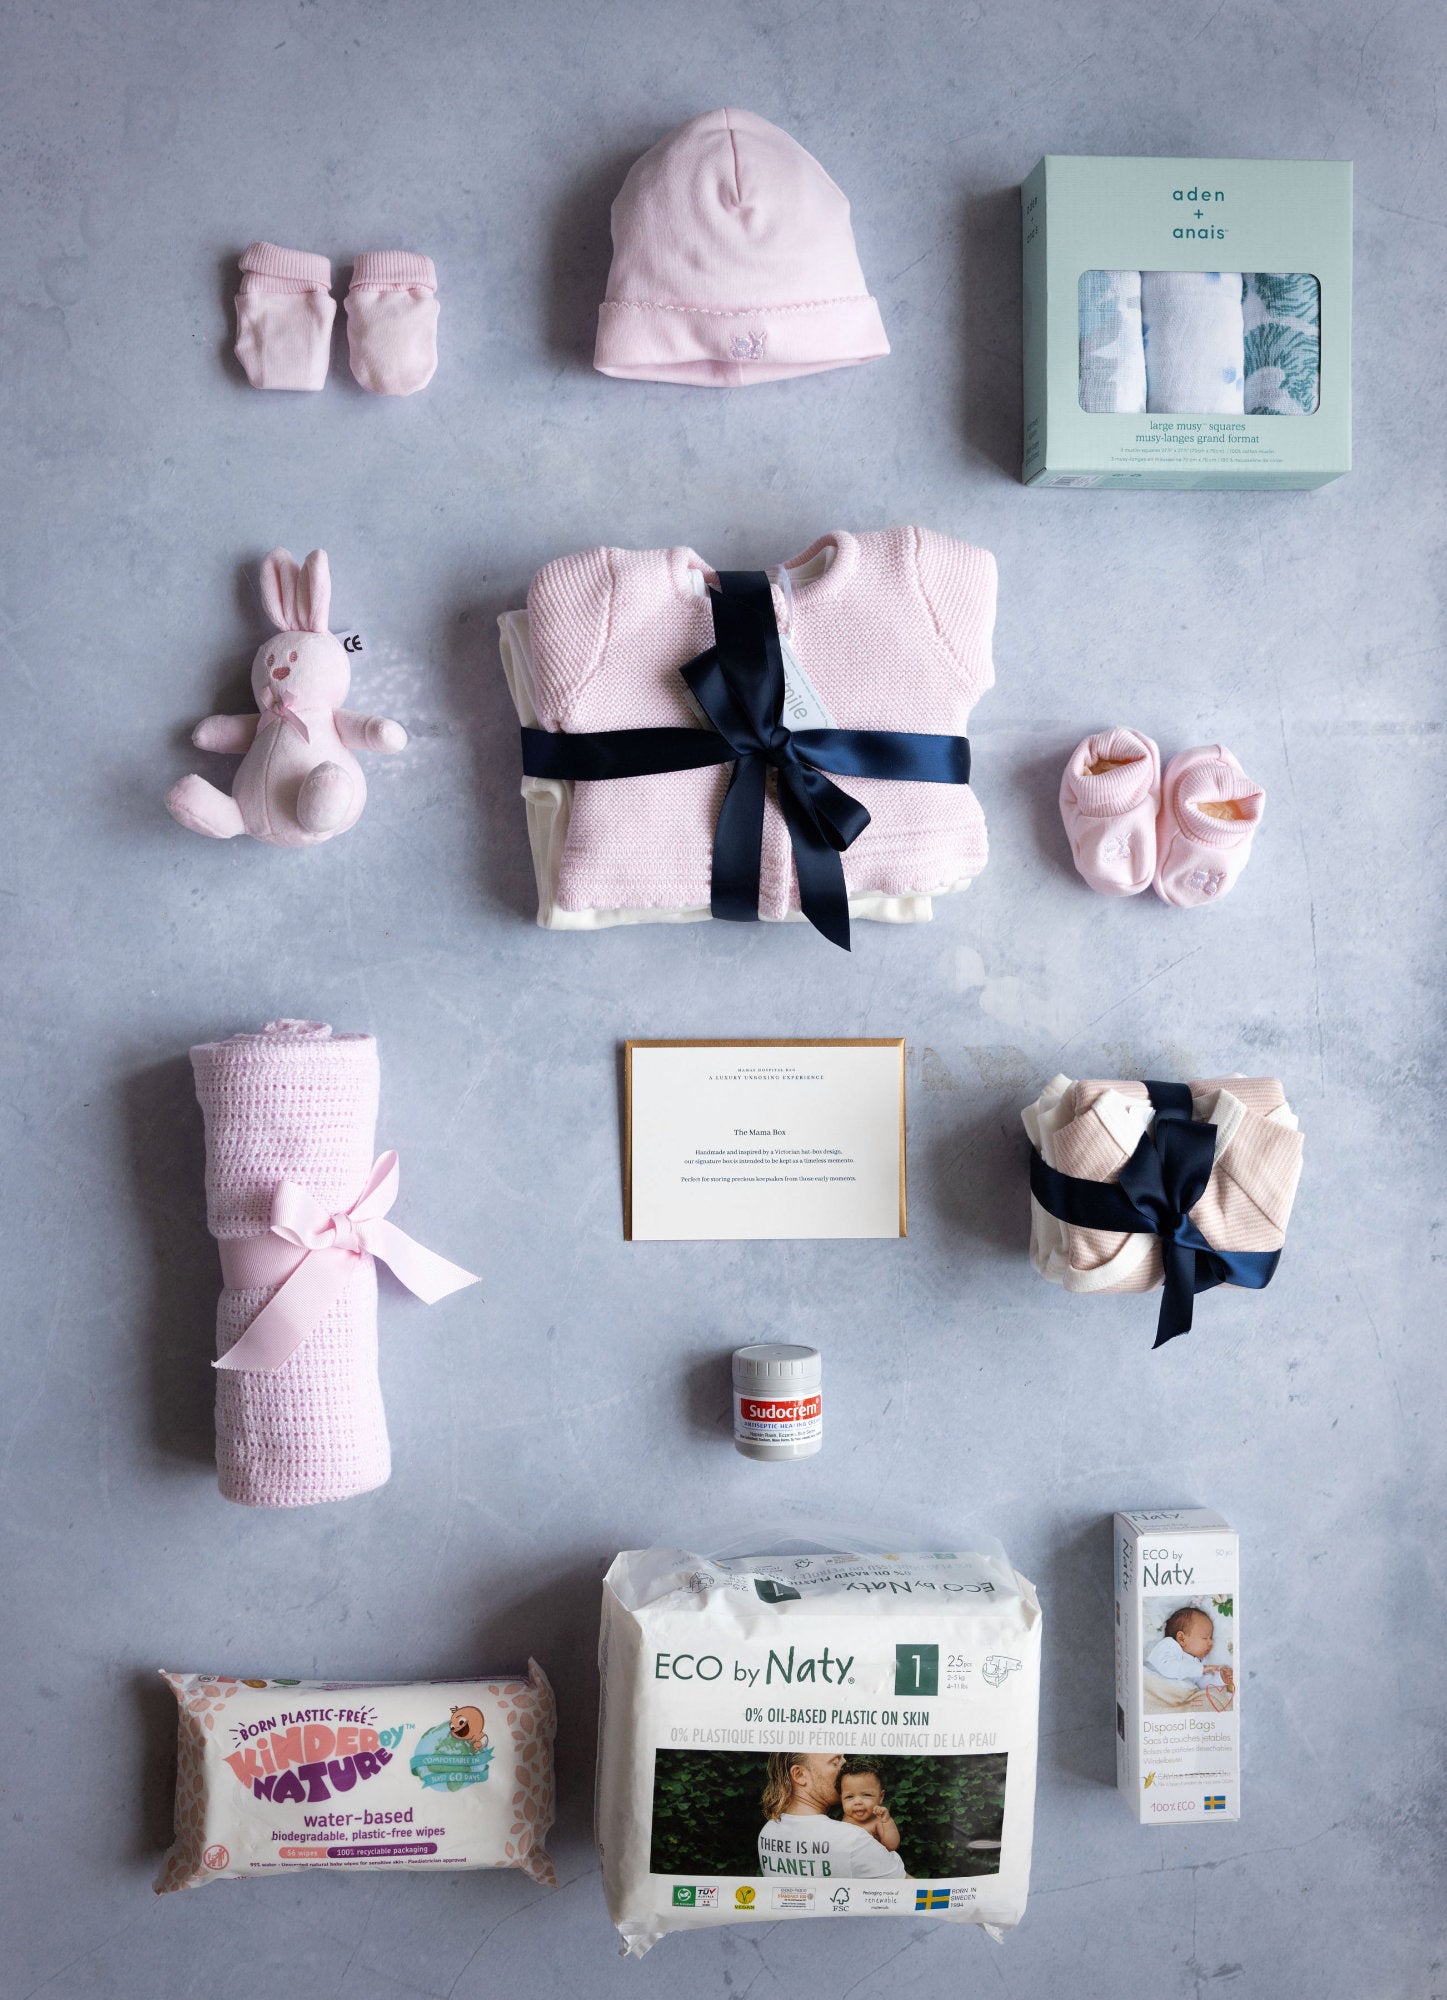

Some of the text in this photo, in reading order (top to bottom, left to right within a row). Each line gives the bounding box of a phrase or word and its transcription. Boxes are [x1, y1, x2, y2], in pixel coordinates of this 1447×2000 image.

[1173, 187, 1225, 201] aden
[1173, 225, 1225, 239] anais
[1150, 421, 1174, 432] large
[1209, 423, 1246, 433] squares
[1136, 433, 1260, 444] musy-langes grand format
[343, 634, 363, 653] CE
[785, 681, 808, 720] mile
[738, 1149, 762, 1157] inspired
[749, 1403, 817, 1419] Sudocrem
[743, 1421, 778, 1429] ANTISEPTIC
[1142, 1549, 1183, 1561] ECO by
[1143, 1563, 1194, 1588] Naty
[846, 1581, 912, 1594] Naty
[914, 1580, 936, 1590] by
[943, 1582, 995, 1593] ECO
[655, 1646, 855, 1687] ECO by Naty
[947, 1655, 964, 1667] 25
[911, 1655, 921, 1688] 1
[745, 1707, 930, 1726] 0% OIL-BASED PLASTIC ON SKIN
[239, 1708, 368, 1741] BORN PLASTIC-FREE
[1143, 1718, 1216, 1735] Disposal Bags
[378, 1724, 404, 1749] BY
[670, 1727, 997, 1748] 0% PLASTIQUE ISSU DU PÉTROLE AU CONTACT DE LA PEAU
[1143, 1736, 1161, 1745] Sacs
[1169, 1734, 1200, 1744] couches
[1201, 1732, 1232, 1744] jetables
[422, 1757, 470, 1765] COMPOSTABLE
[254, 1747, 394, 1804] NATURE
[449, 1772, 463, 1782] 60
[1151, 1801, 1196, 1812] 100% ECO
[303, 1807, 414, 1828] water-based
[272, 1826, 446, 1843] biodegradable, plastic-free wipes
[287, 1846, 428, 1858] 56 wipes 100% recyclable packaging
[760, 1836, 830, 1854] THERE IS NO
[761, 1855, 832, 1877] PLANET B
